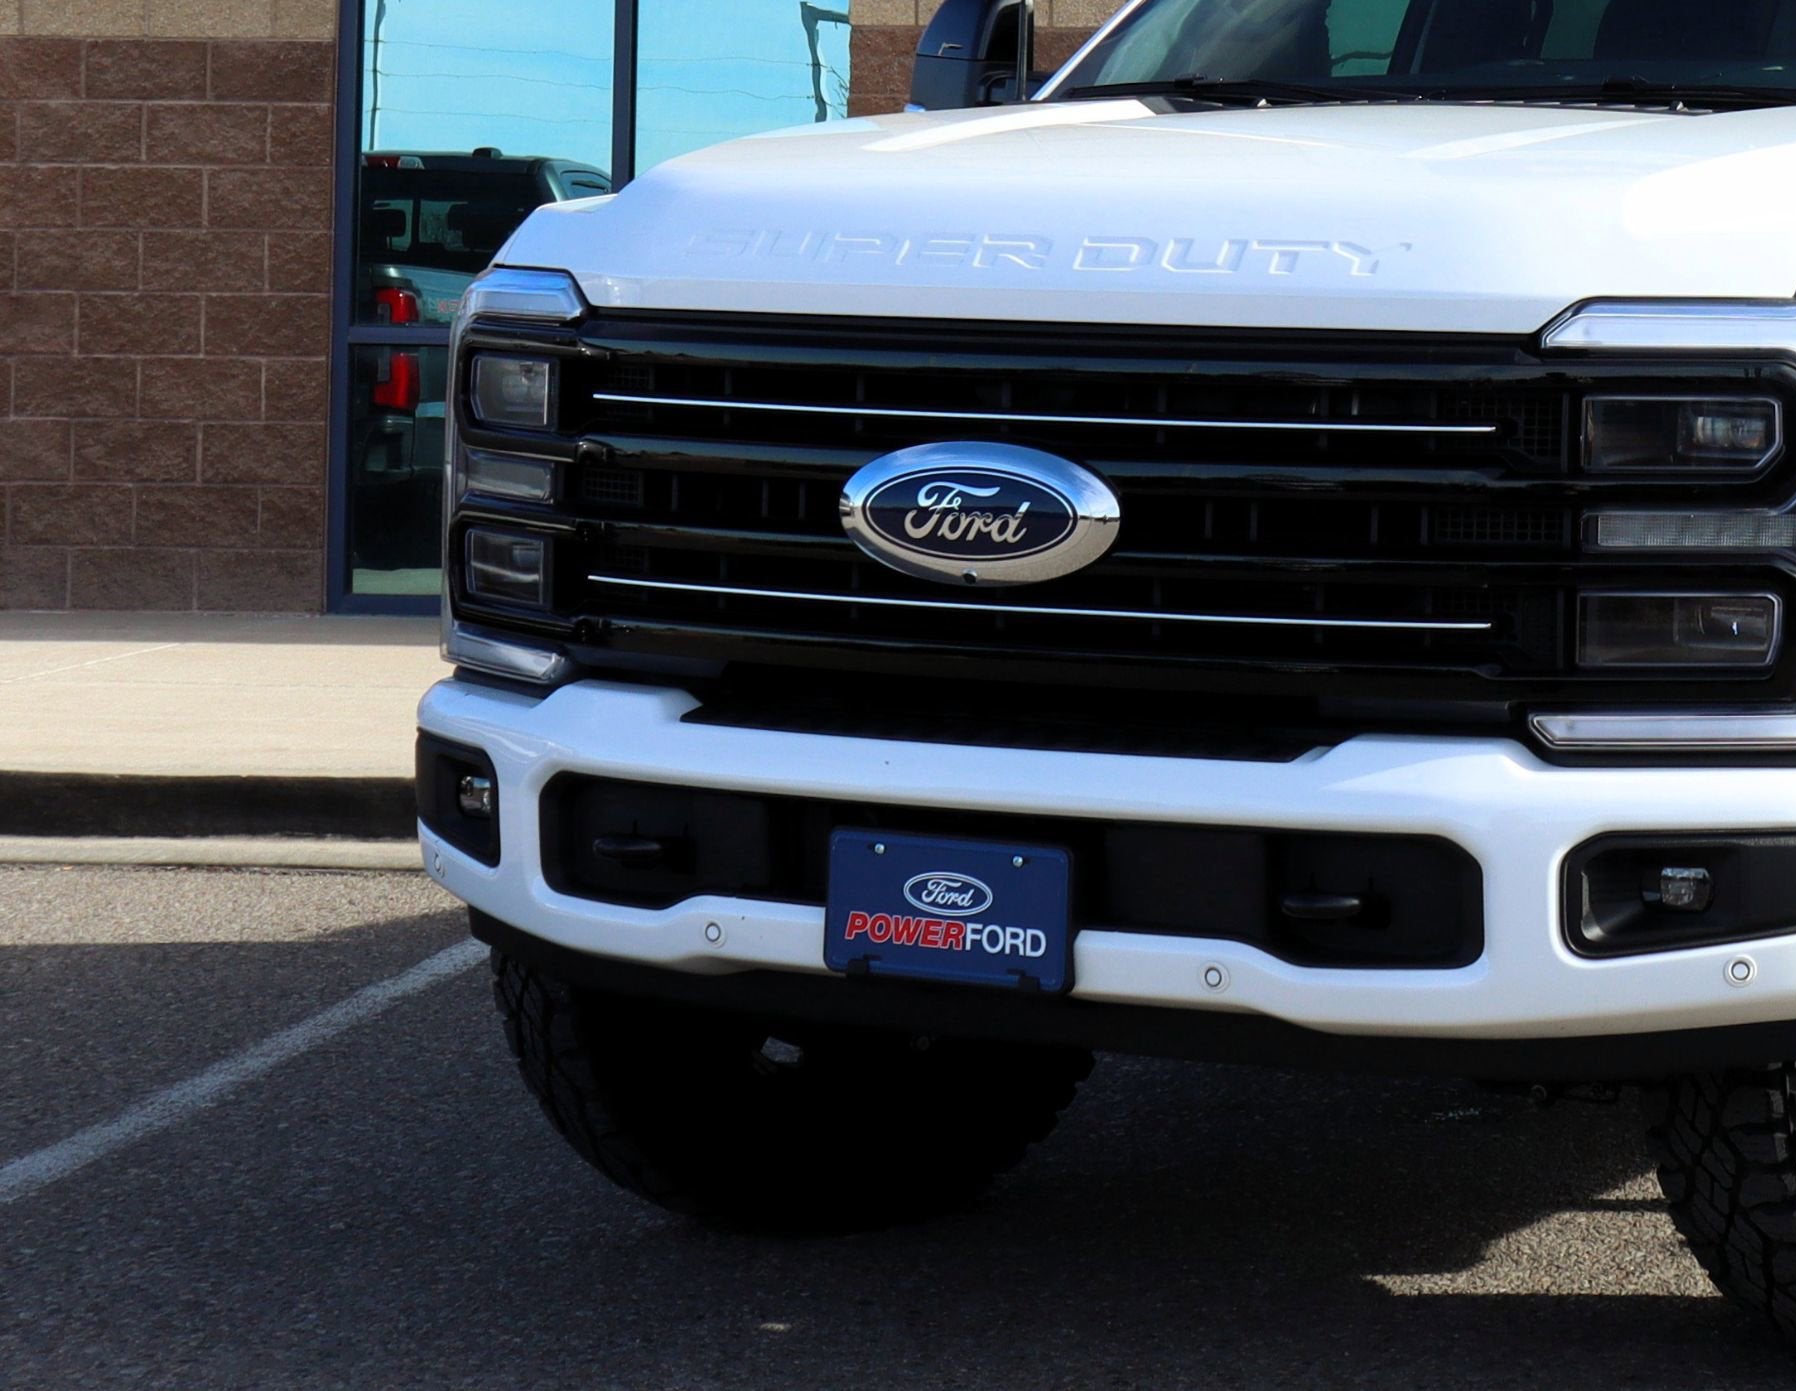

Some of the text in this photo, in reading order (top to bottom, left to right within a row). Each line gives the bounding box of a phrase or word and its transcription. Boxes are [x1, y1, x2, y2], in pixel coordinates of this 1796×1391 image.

[684, 225, 1412, 277] SUPER DUTY
[904, 481, 1031, 543] Ford
[921, 879, 976, 907] Ford
